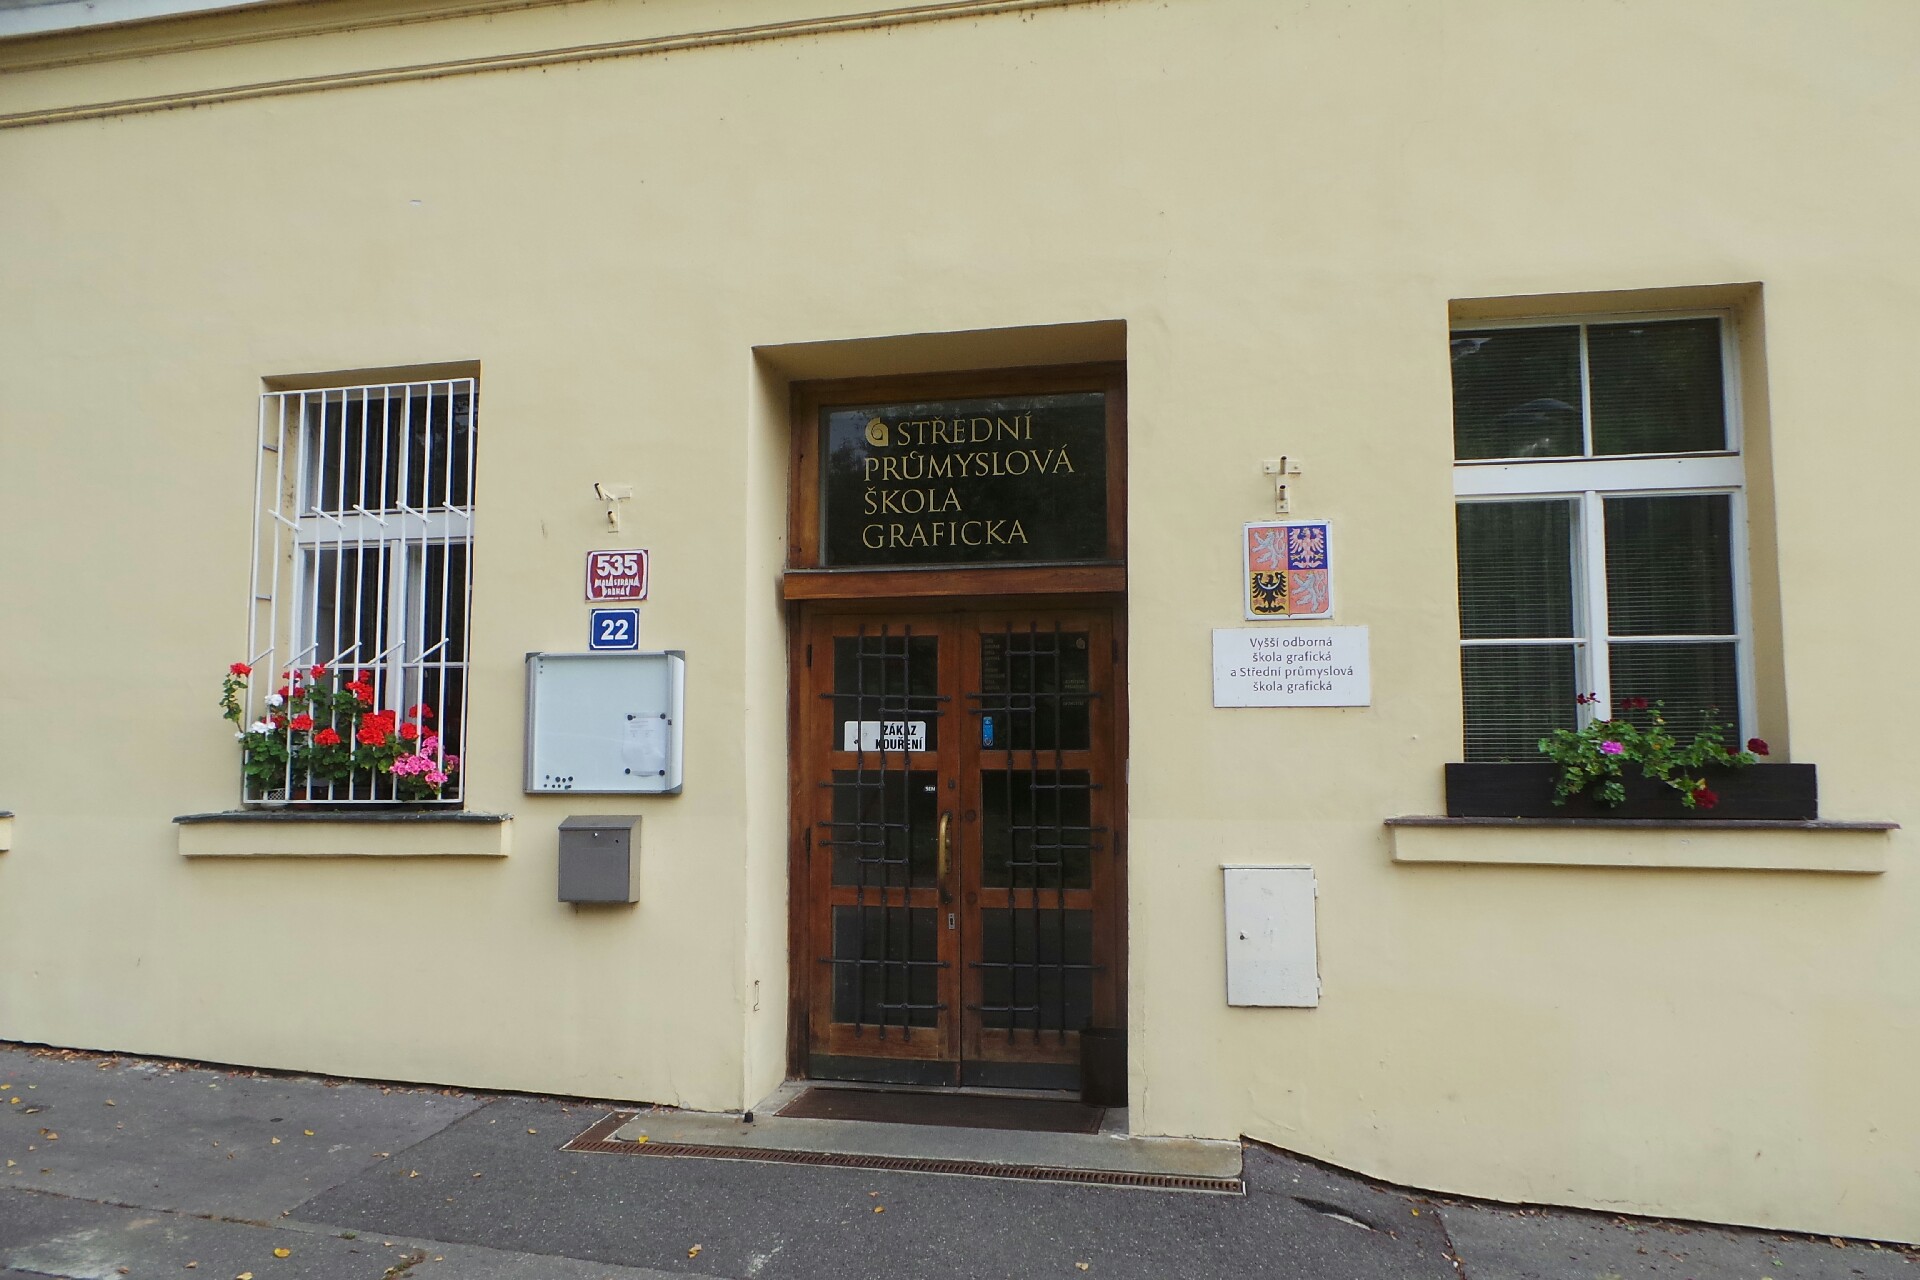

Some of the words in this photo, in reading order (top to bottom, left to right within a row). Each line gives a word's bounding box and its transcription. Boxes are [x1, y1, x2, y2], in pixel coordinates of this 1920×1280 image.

[897, 411, 1033, 446] STŘEDNÍ
[863, 444, 1075, 482] PRŮMYSLOVÁ
[864, 487, 962, 515] ŠKOLA
[596, 554, 638, 576] 535
[600, 619, 629, 640] 22
[1250, 637, 1279, 650] Vyšší
[1282, 636, 1333, 647] odborná
[1252, 651, 1282, 662] škola
[1286, 650, 1332, 664] grafická
[1240, 666, 1281, 677] Střední
[1285, 665, 1353, 679] průmyslová
[1253, 681, 1283, 691] škola
[1287, 680, 1333, 694] grafická
